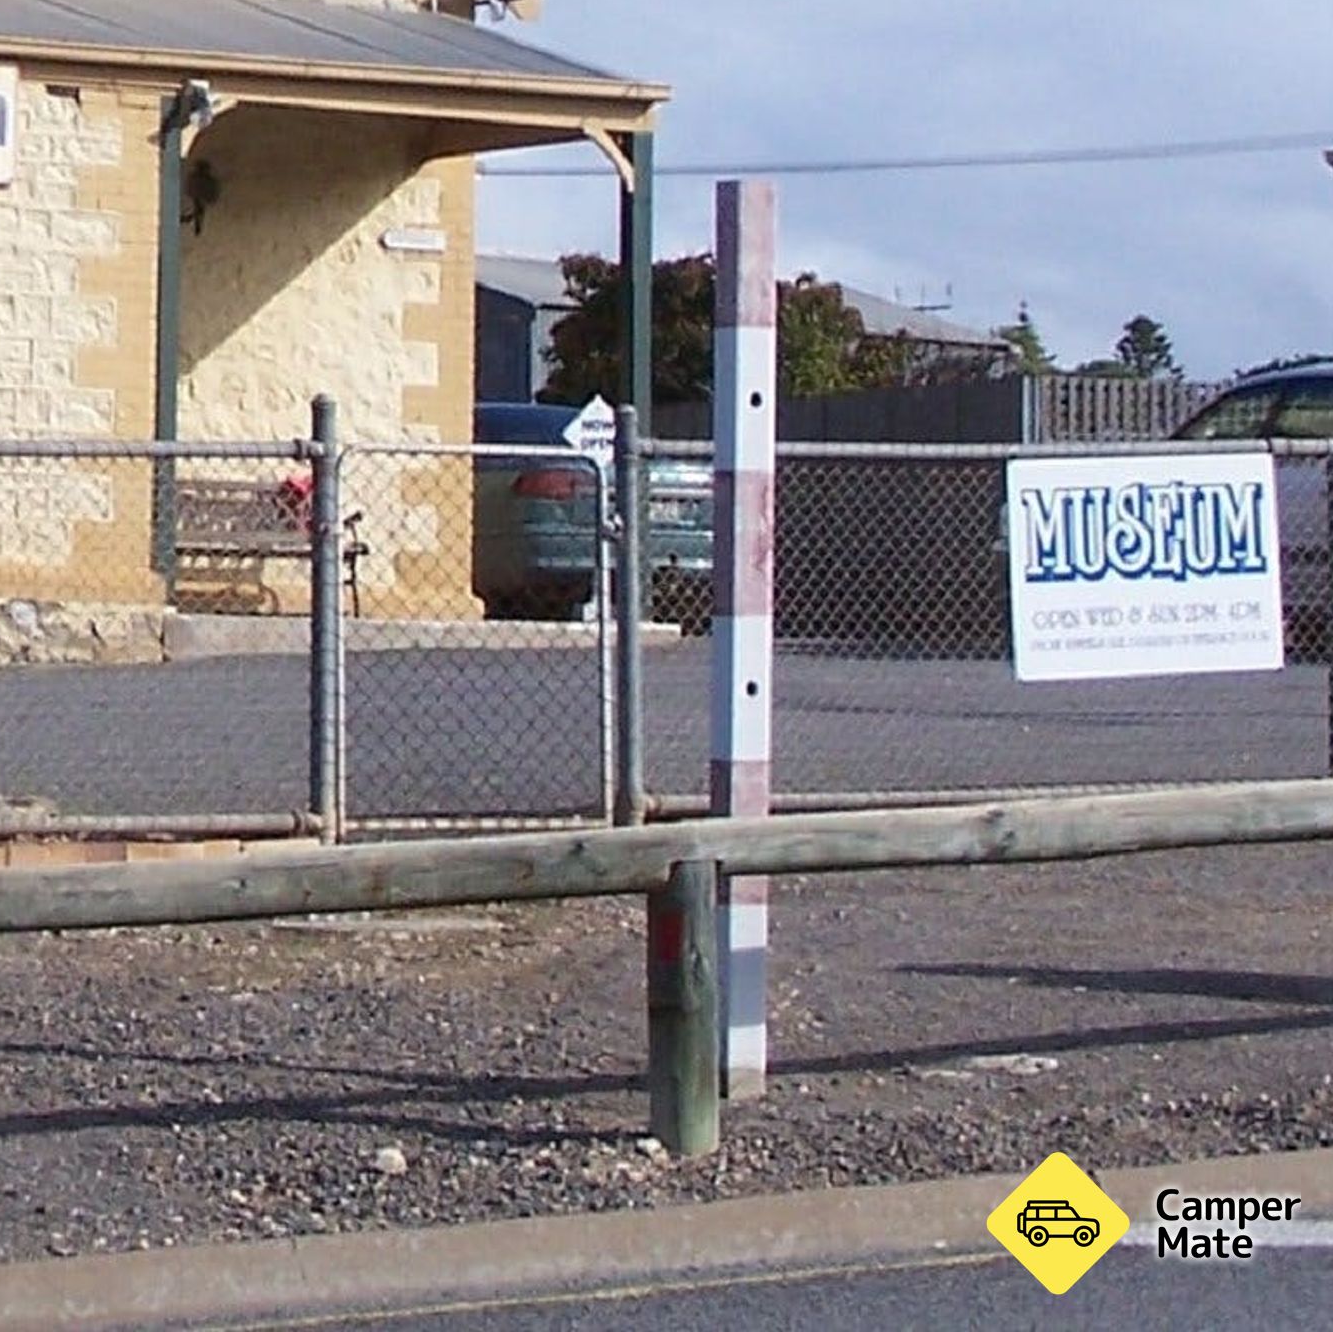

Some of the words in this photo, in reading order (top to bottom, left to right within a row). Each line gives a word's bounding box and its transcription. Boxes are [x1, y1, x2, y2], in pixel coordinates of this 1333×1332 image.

[582, 420, 614, 431] NOW
[1021, 480, 1267, 583] MUSEUM
[1032, 608, 1080, 630] OPEN
[1085, 606, 1123, 627] WED
